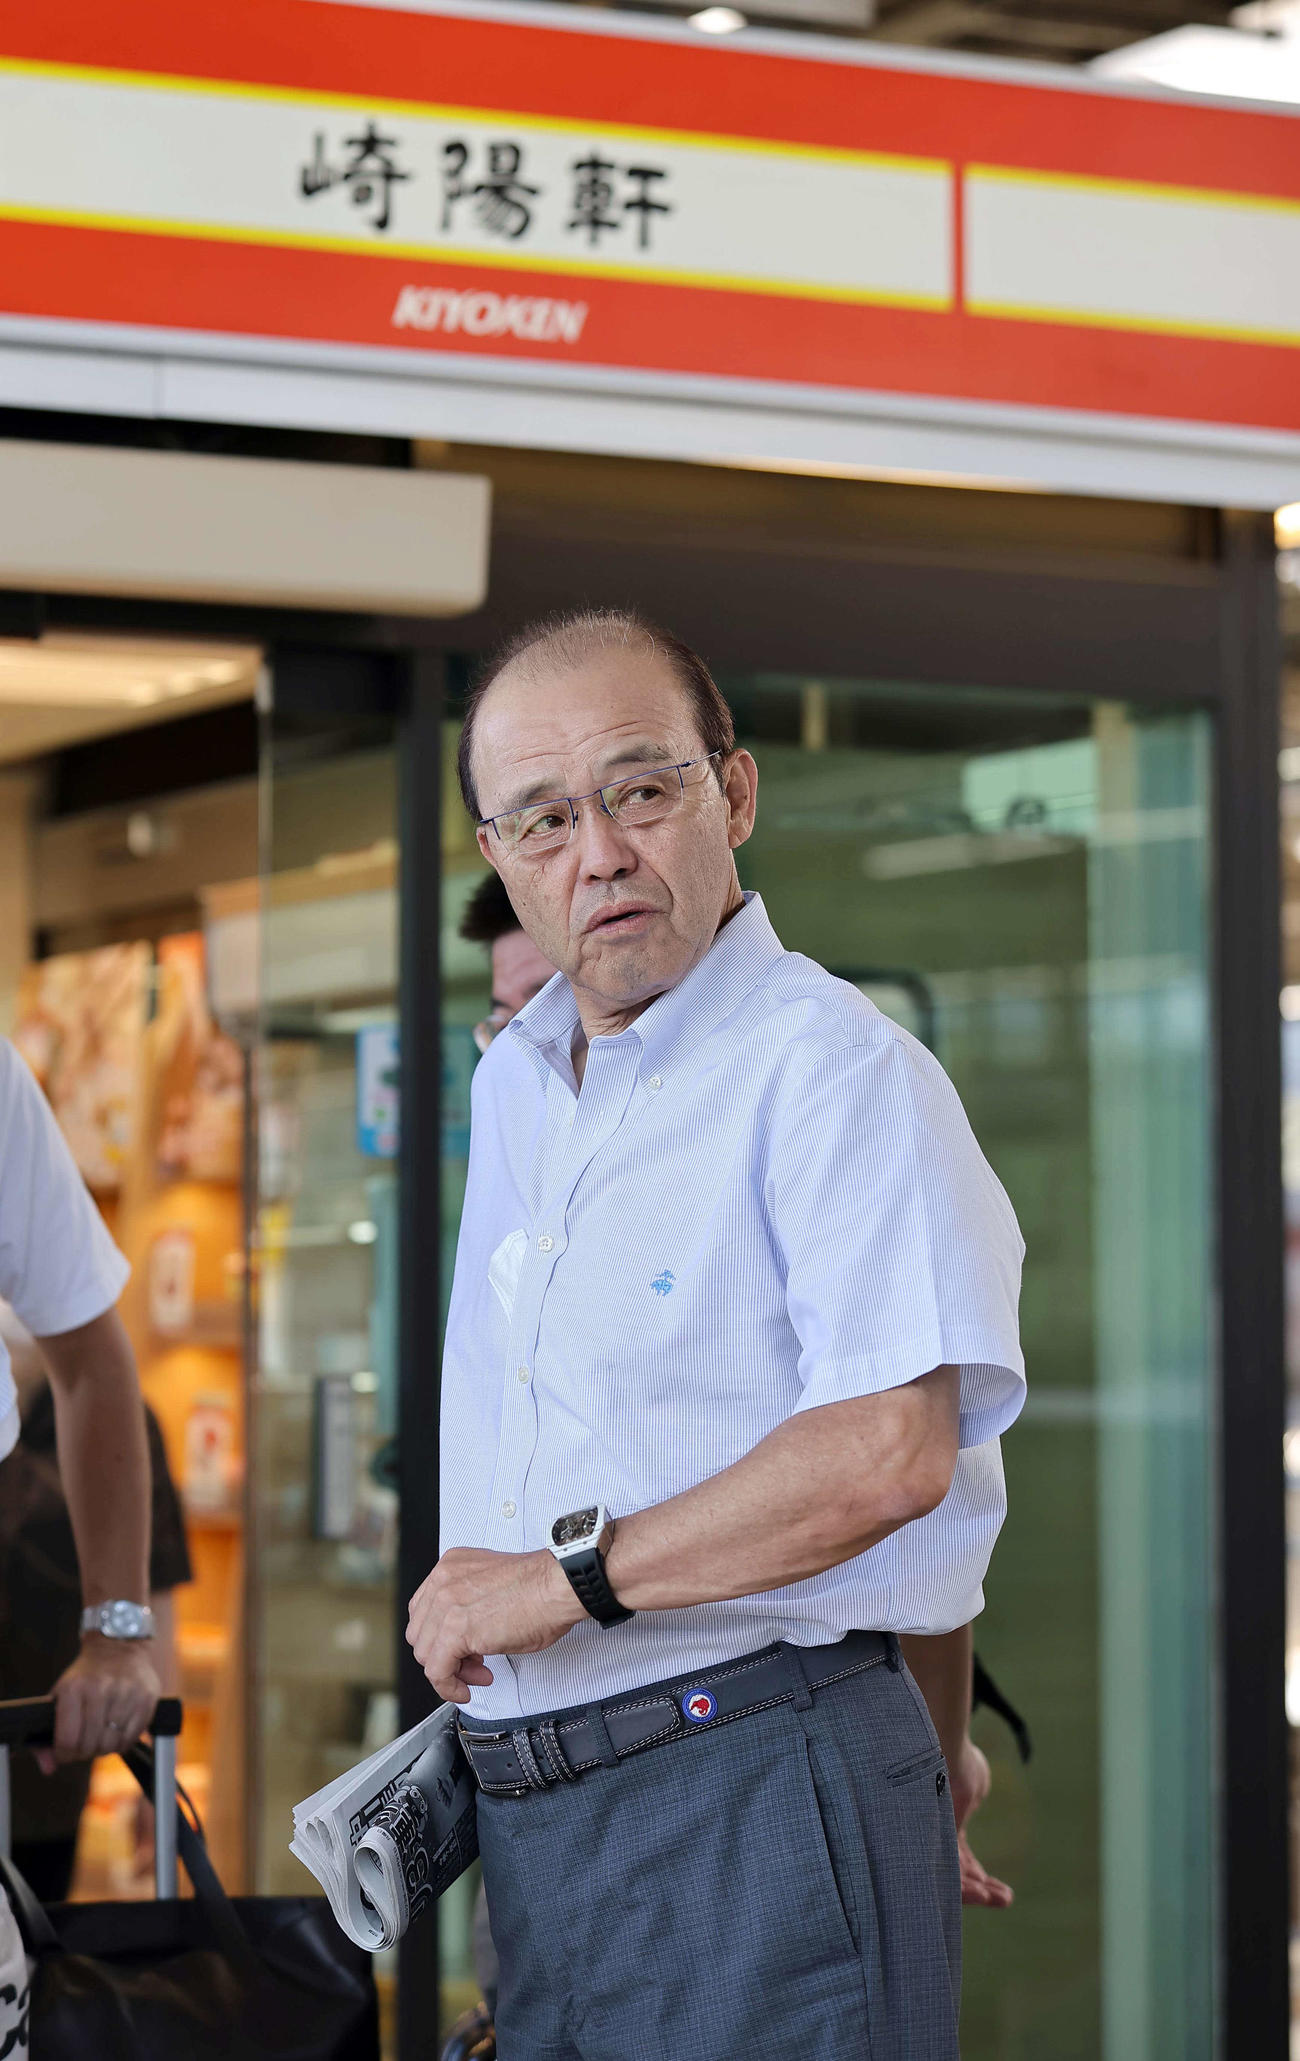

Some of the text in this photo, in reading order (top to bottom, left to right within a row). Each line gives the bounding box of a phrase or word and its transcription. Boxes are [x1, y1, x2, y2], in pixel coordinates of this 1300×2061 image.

[301, 118, 672, 250] 崎陽軒
[393, 285, 588, 344] KIYOKEN
